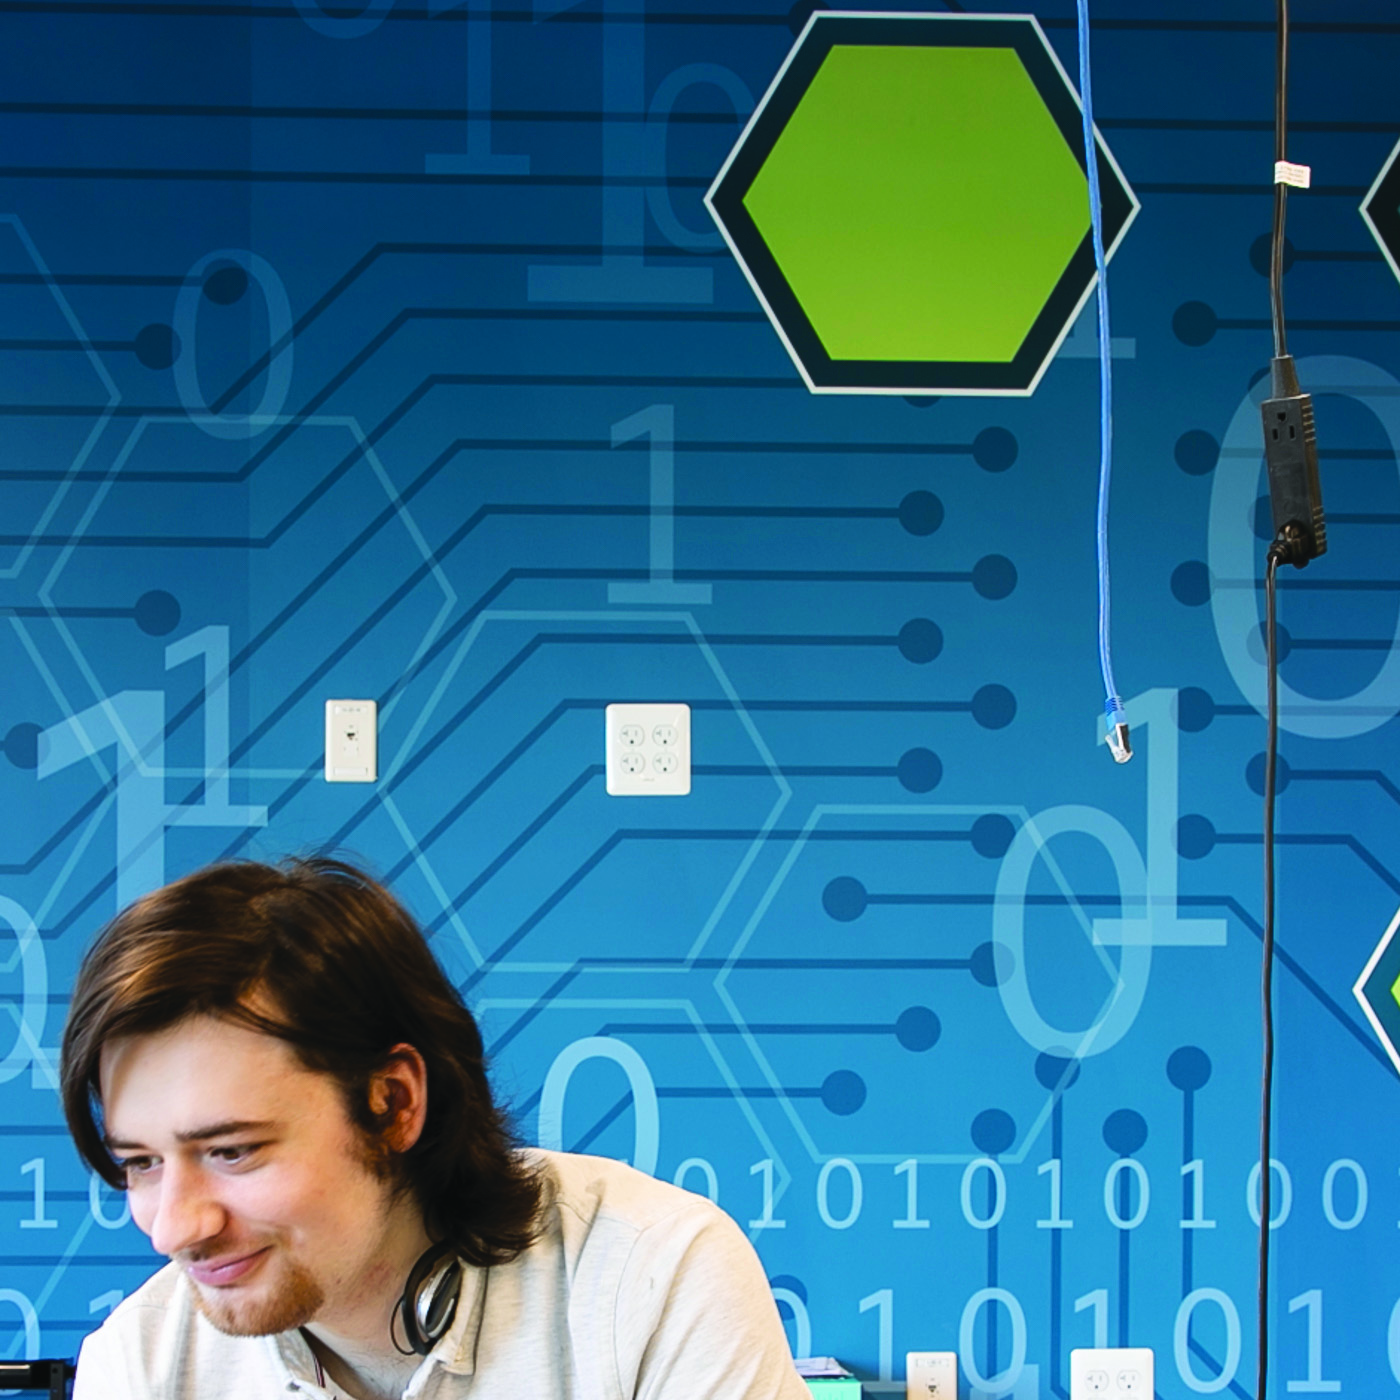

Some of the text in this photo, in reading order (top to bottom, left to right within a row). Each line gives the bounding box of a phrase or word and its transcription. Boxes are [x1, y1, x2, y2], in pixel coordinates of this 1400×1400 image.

[172, 248, 295, 440] 0
[608, 404, 713, 605] 1
[162, 625, 269, 828] 1
[1092, 687, 1228, 947] 1
[992, 805, 1154, 1059] 0
